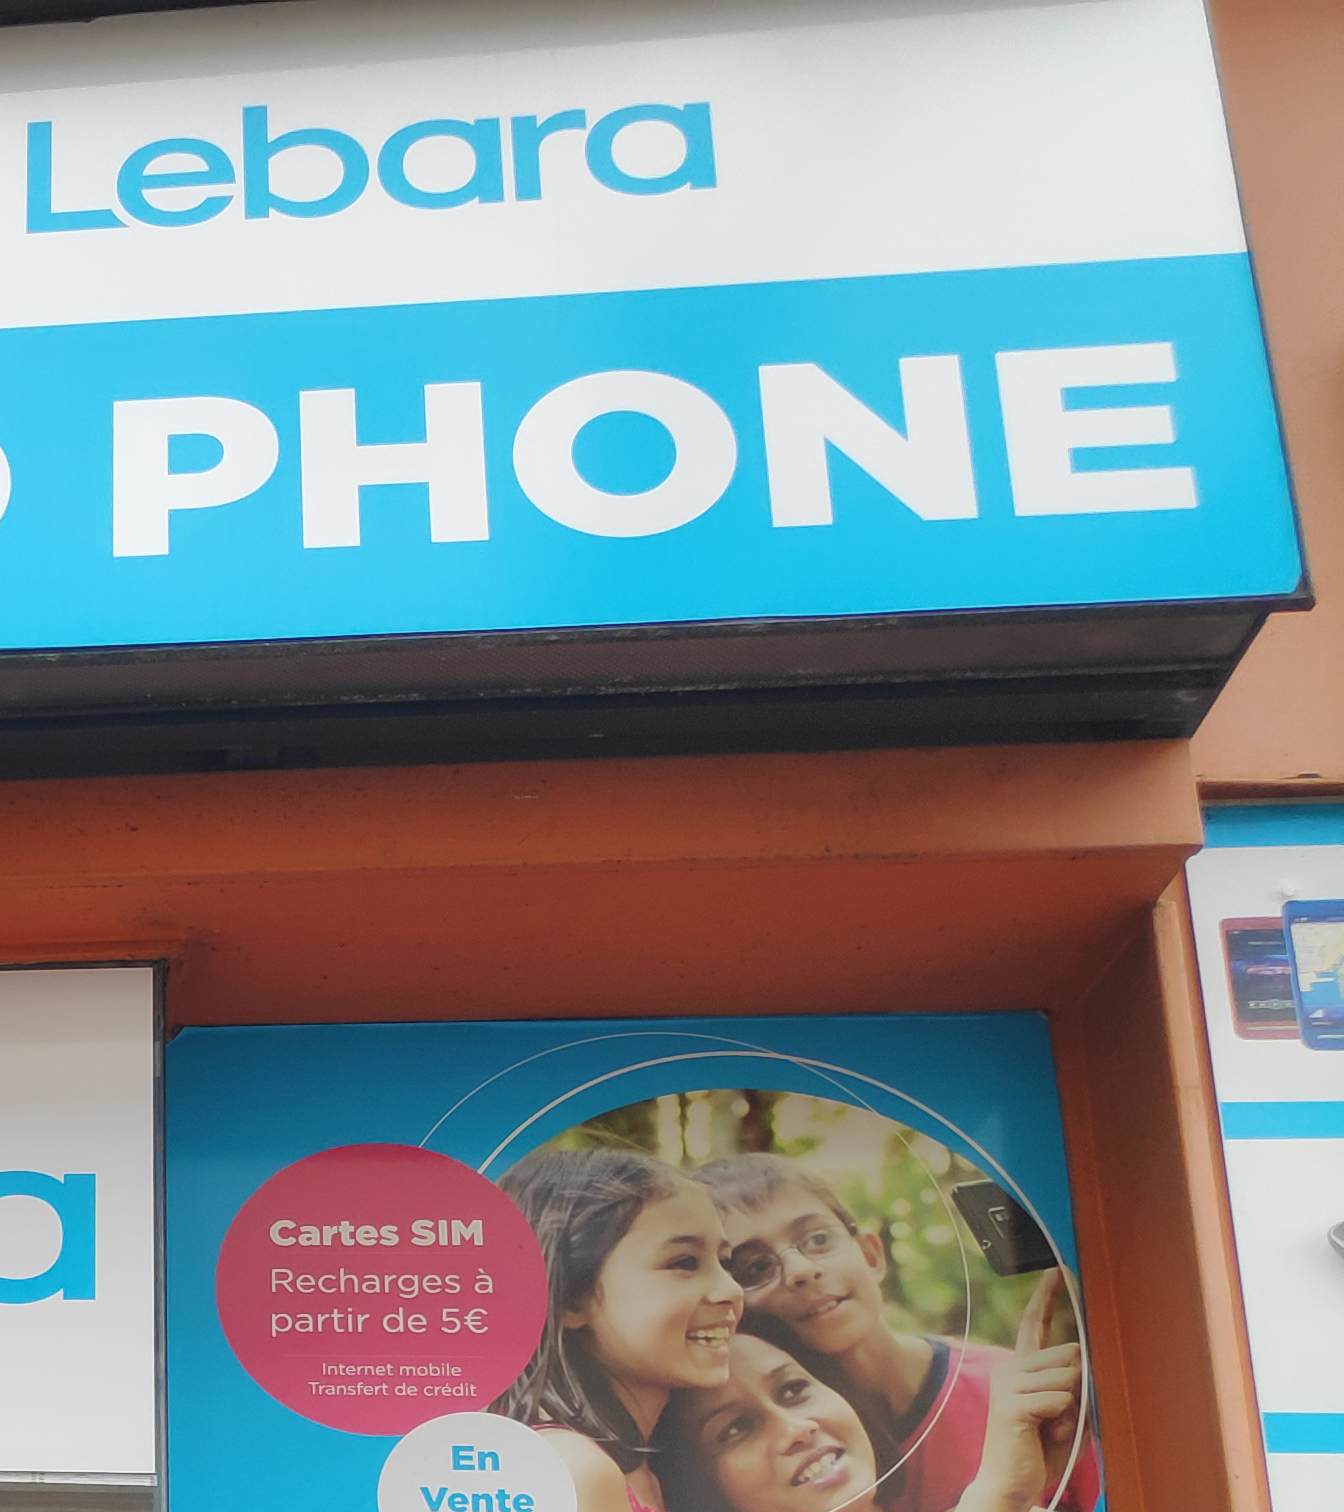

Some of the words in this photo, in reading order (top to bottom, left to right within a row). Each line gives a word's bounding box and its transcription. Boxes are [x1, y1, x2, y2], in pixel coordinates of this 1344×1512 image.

[25, 100, 718, 234] Lebara
[112, 341, 1200, 559] PHONE
[269, 1219, 400, 1247] Cartes
[410, 1219, 484, 1247] SIM
[271, 1268, 461, 1299] Recharges
[473, 1269, 494, 1294] à
[271, 1307, 370, 1337] partir
[382, 1308, 428, 1333] de
[440, 1308, 489, 1334] 5€
[322, 1362, 394, 1377] Internet
[399, 1363, 463, 1377] mobile
[308, 1381, 389, 1397] Transfert
[394, 1382, 418, 1397] de
[423, 1381, 477, 1398] crédit
[451, 1444, 501, 1472] En
